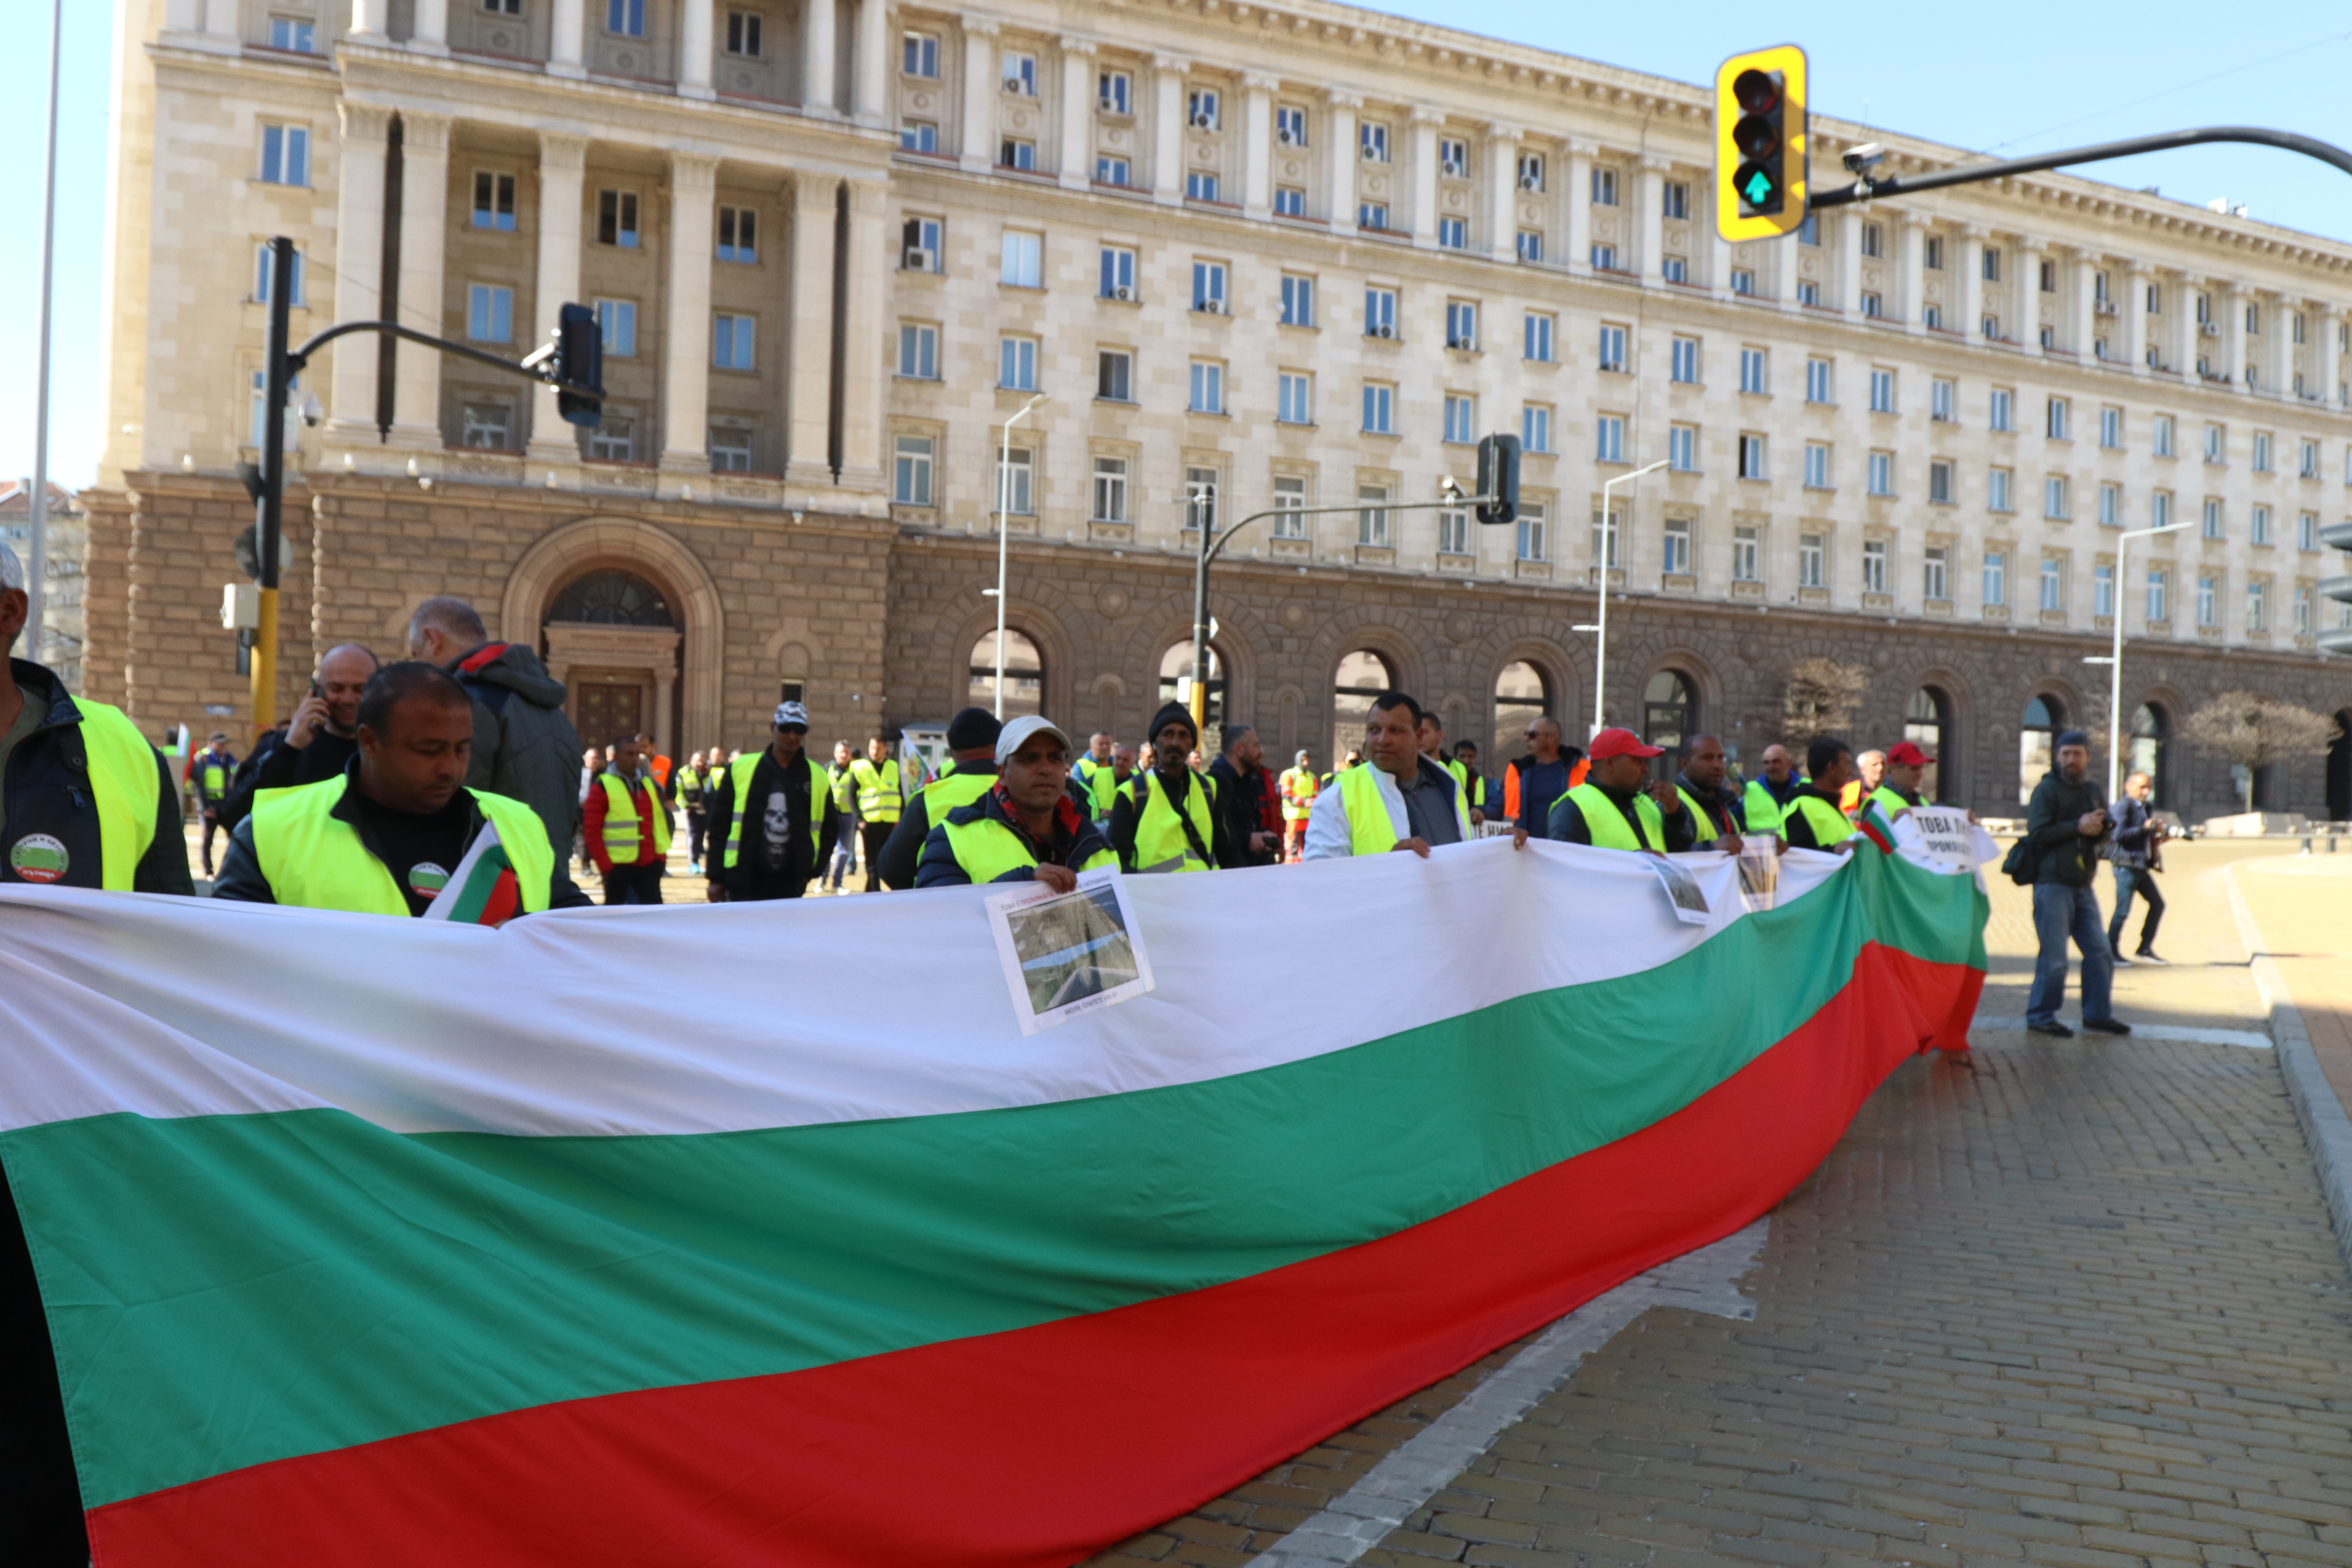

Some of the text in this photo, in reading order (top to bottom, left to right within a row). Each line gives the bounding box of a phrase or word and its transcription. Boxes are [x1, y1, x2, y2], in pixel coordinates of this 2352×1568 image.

[1916, 816, 1953, 833] ТОВА
[22, 869, 55, 879] ПЪТИЩА
[1065, 1005, 1081, 1015] МОЛЯ,
[1082, 998, 1103, 1009] ПЛАТЕТЕ
